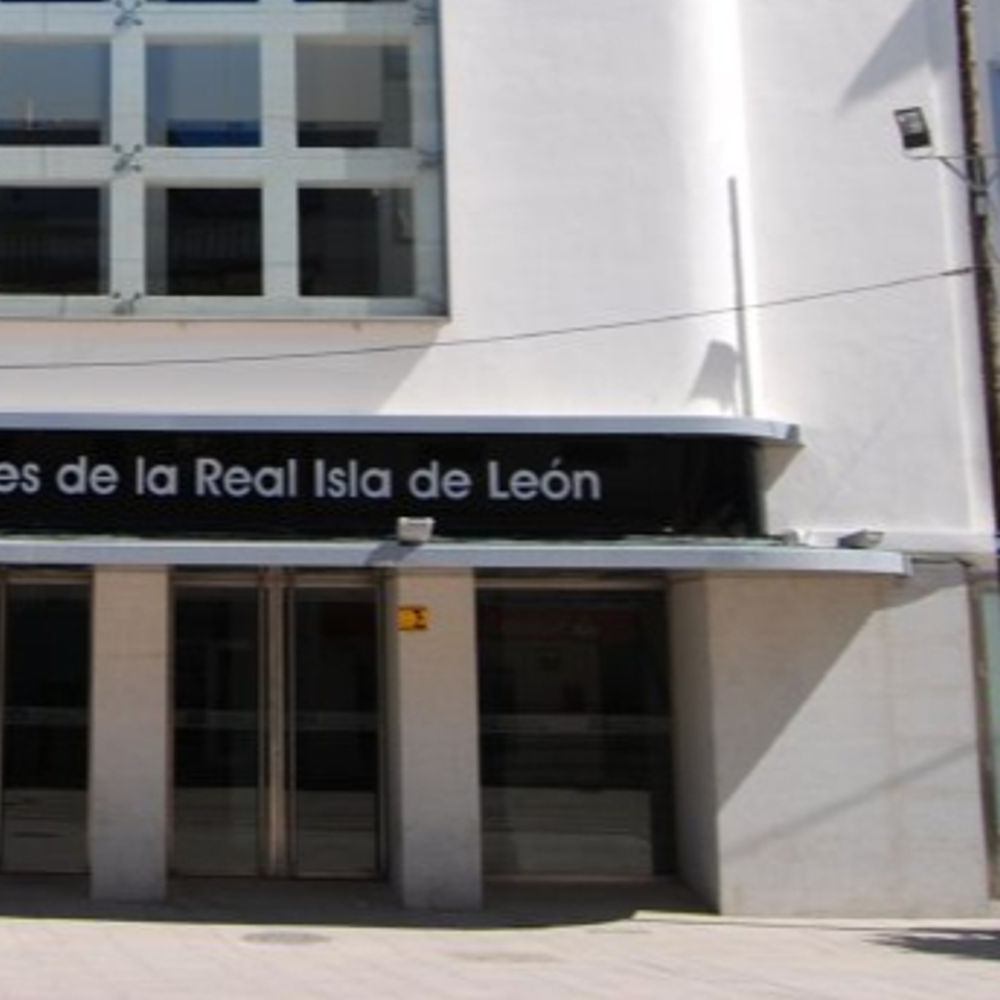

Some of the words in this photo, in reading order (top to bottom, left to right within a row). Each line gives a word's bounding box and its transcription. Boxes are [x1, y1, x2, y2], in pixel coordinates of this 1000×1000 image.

[56, 455, 119, 496] de
[136, 456, 179, 496] la
[195, 457, 298, 498] Real
[314, 459, 391, 499] Isla
[409, 461, 473, 500] de
[488, 458, 602, 501] León
